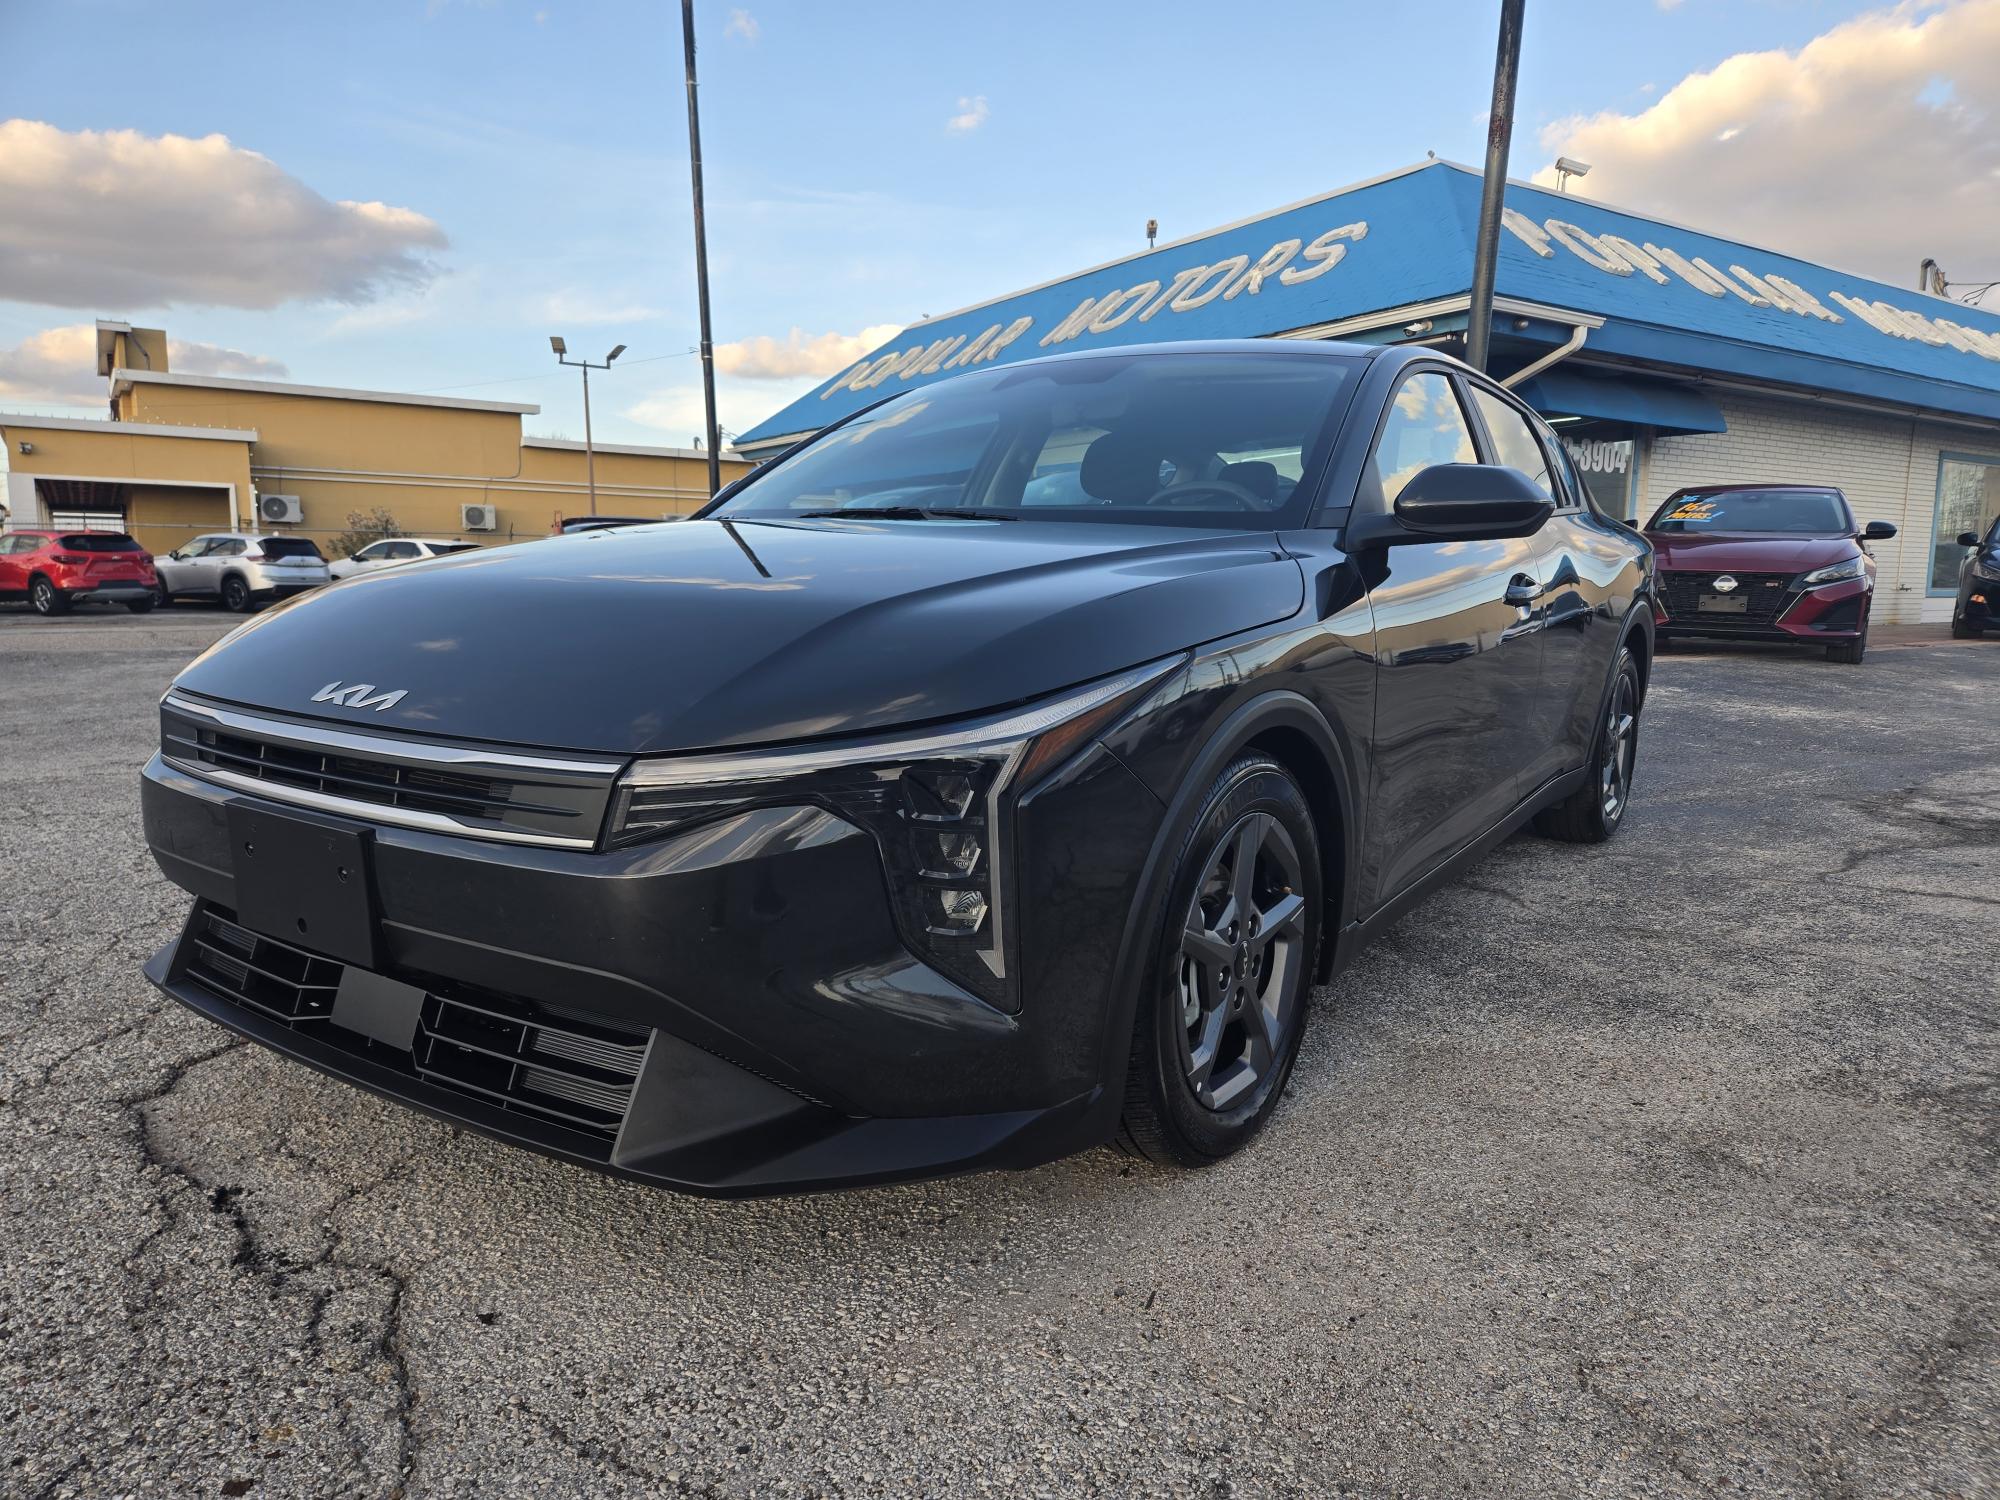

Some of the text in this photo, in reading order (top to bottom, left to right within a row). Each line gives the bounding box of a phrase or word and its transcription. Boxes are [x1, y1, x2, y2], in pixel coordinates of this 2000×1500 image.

[819, 221, 1369, 401] POPULAR MOTORS
[310, 680, 409, 712] KIA
